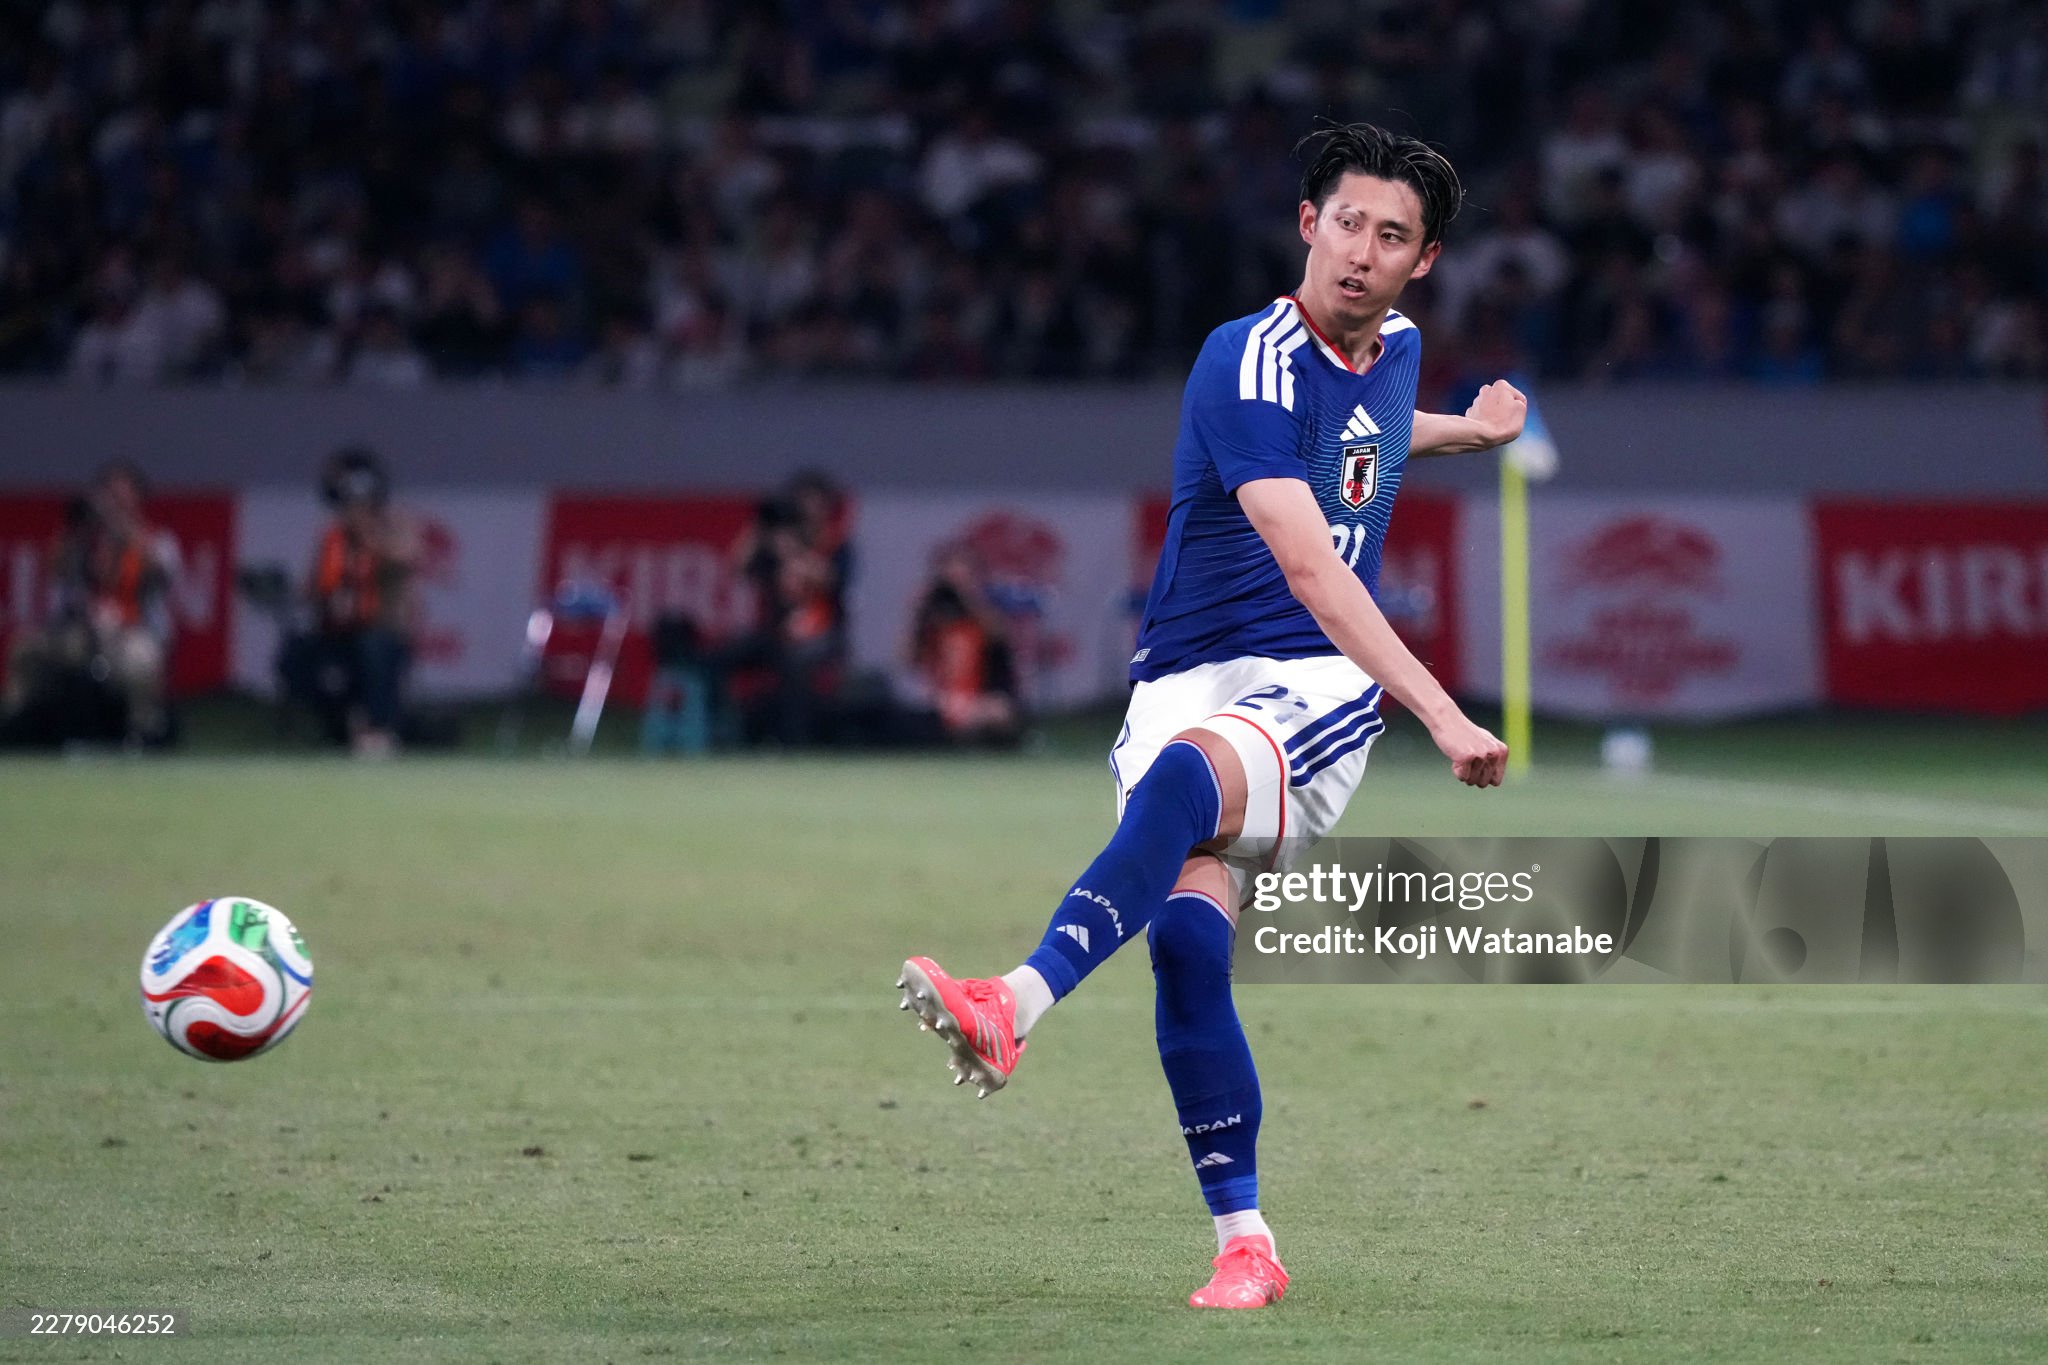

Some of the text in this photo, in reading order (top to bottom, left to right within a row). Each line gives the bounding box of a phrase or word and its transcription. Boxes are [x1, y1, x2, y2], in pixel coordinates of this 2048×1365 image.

[1352, 447, 1371, 455] JAPAN
[1069, 887, 1124, 938] JAPAN
[1180, 1113, 1241, 1135] APAN
